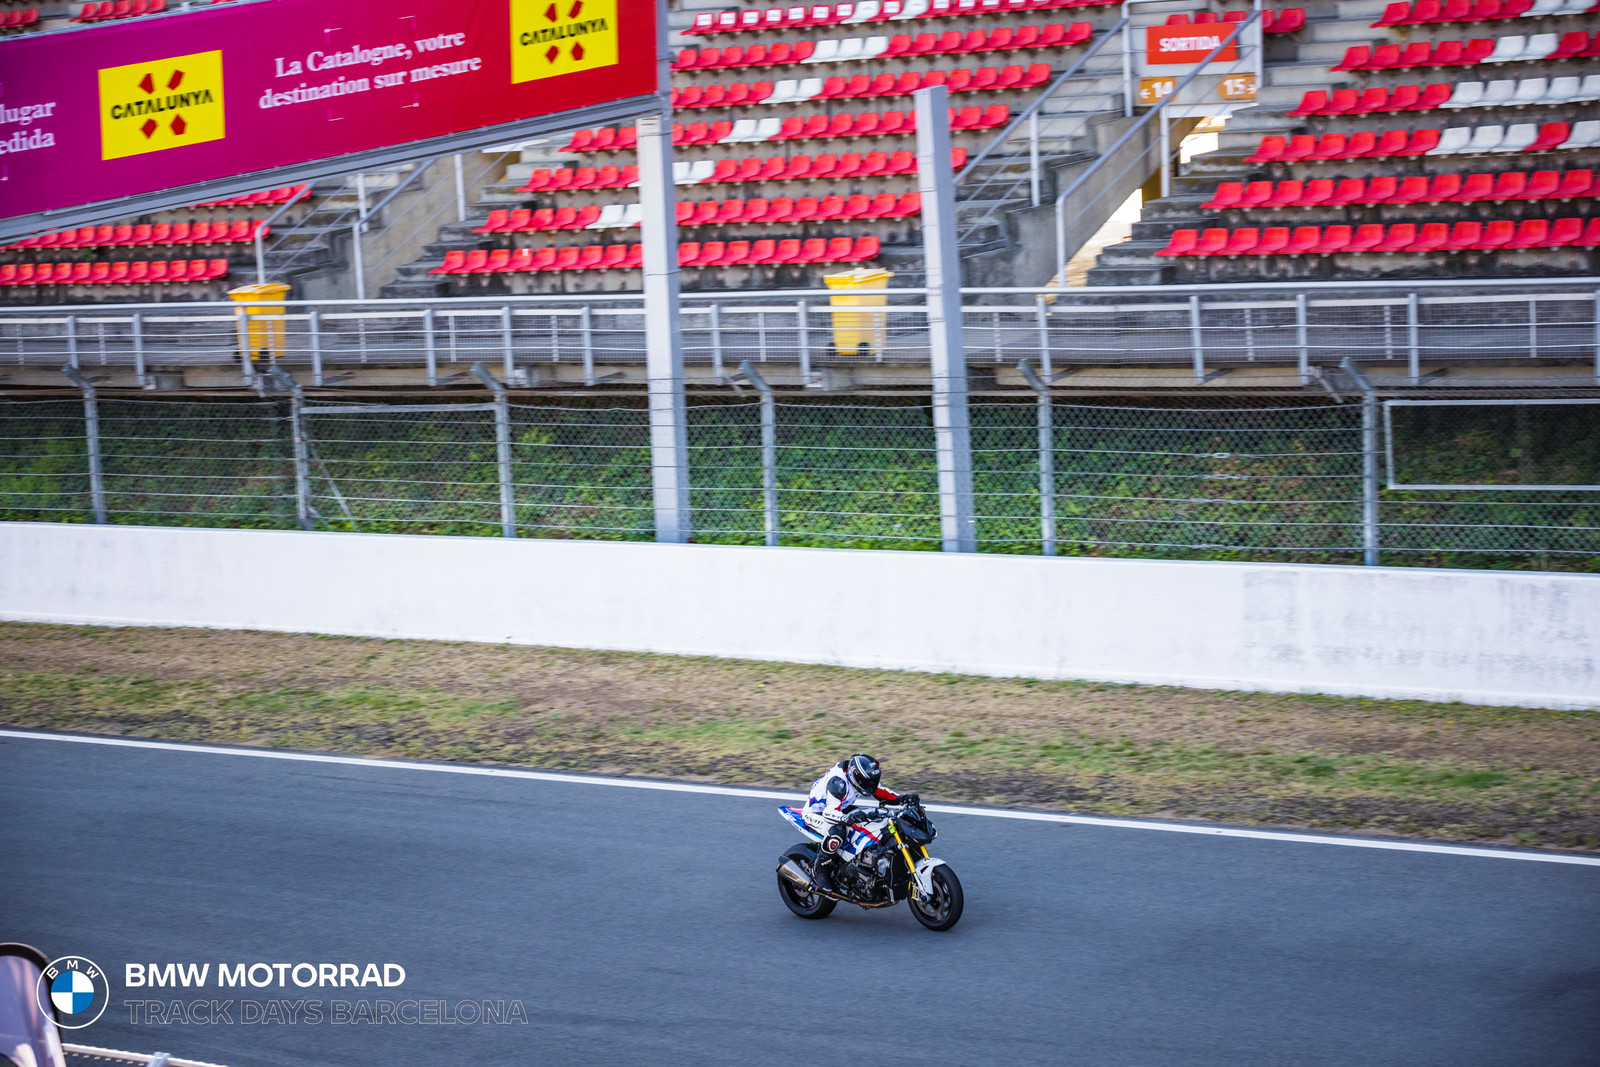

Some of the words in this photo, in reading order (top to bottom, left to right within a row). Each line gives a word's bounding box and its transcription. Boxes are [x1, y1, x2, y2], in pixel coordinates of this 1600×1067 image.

[521, 21, 608, 46] CATALUNYA
[1159, 36, 1221, 52] SORTIDA
[275, 57, 302, 78] La
[307, 42, 412, 72] Catalogne,
[415, 31, 466, 54] votre
[259, 76, 370, 109] destination
[373, 70, 406, 88] sur
[410, 57, 482, 82] mesure
[1152, 82, 1174, 98] 14
[1223, 79, 1246, 95] 15
[0, 102, 56, 125] lugar
[111, 89, 213, 119] CATALUNYA
